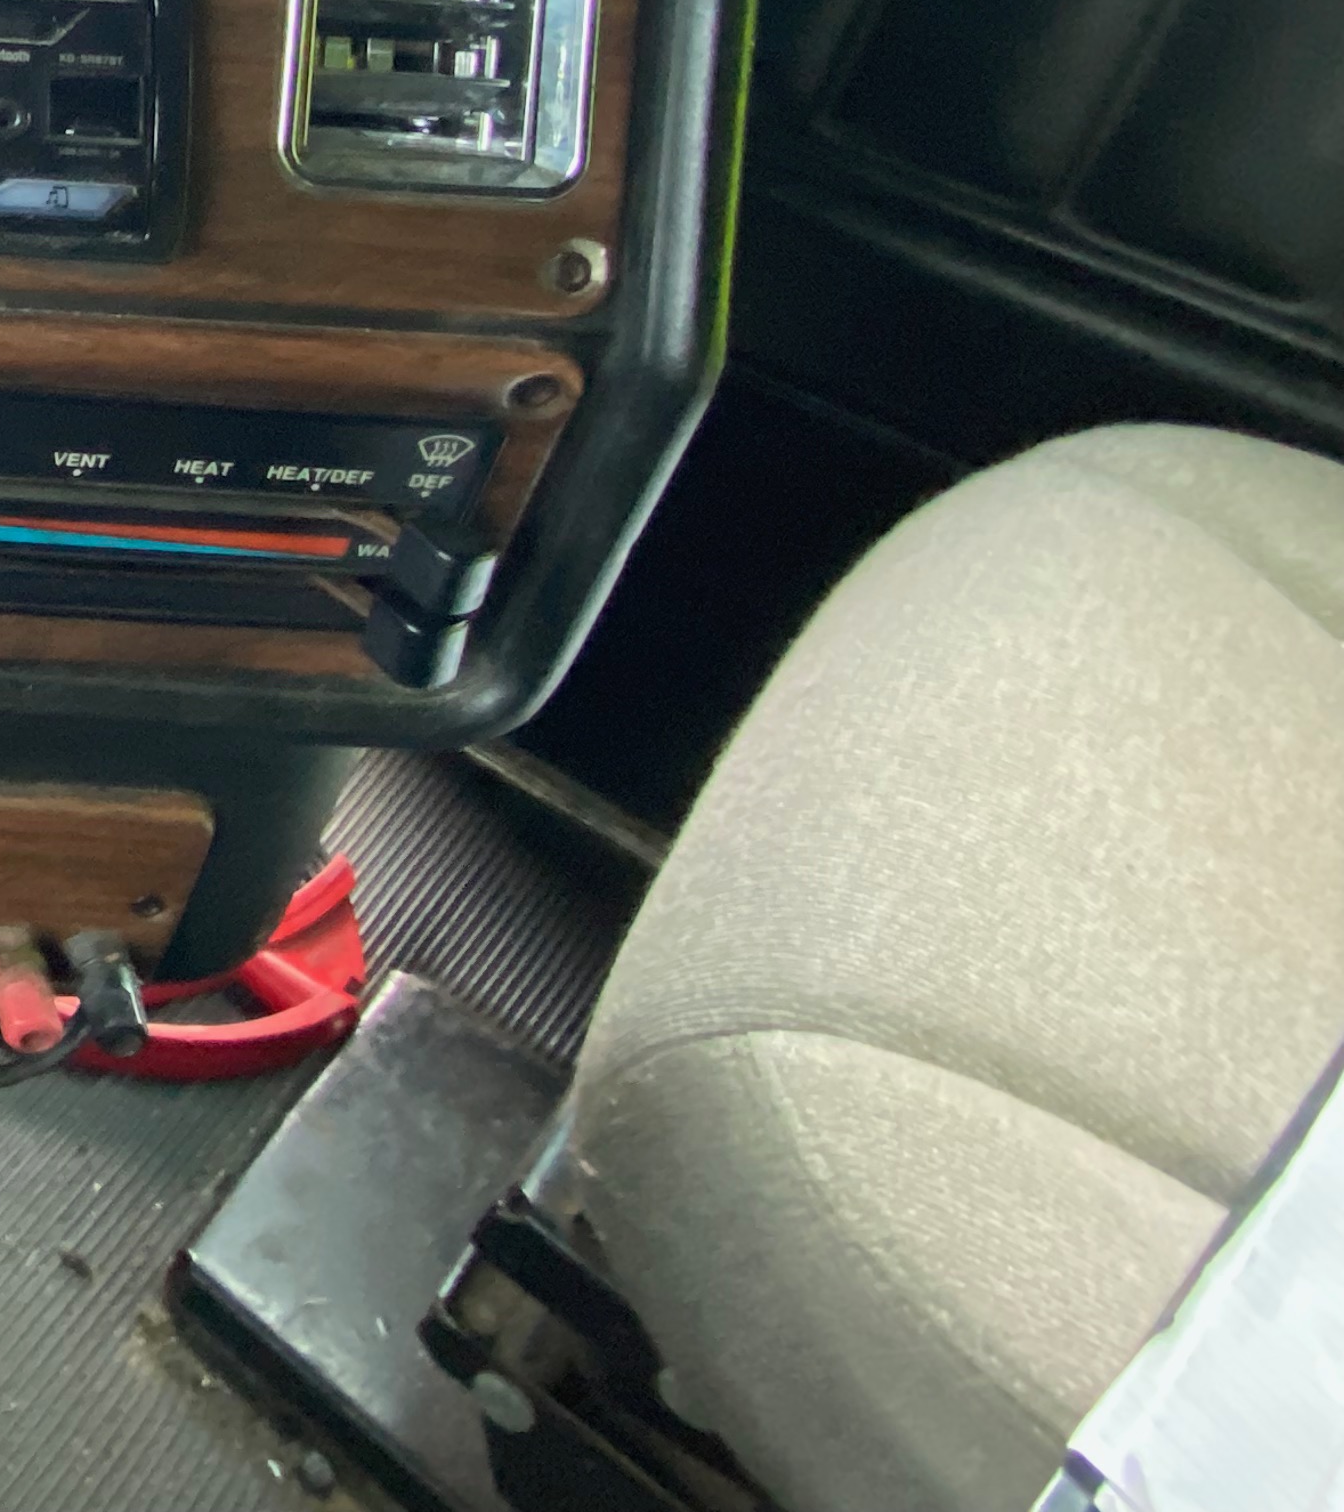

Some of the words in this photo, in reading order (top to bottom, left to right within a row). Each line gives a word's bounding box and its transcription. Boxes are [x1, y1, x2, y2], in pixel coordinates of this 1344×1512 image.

[54, 452, 111, 469] VENT
[174, 460, 235, 476] HEAT
[267, 465, 375, 484] HEAT/DEF
[408, 474, 455, 489] DEF
[358, 544, 391, 558] WA
